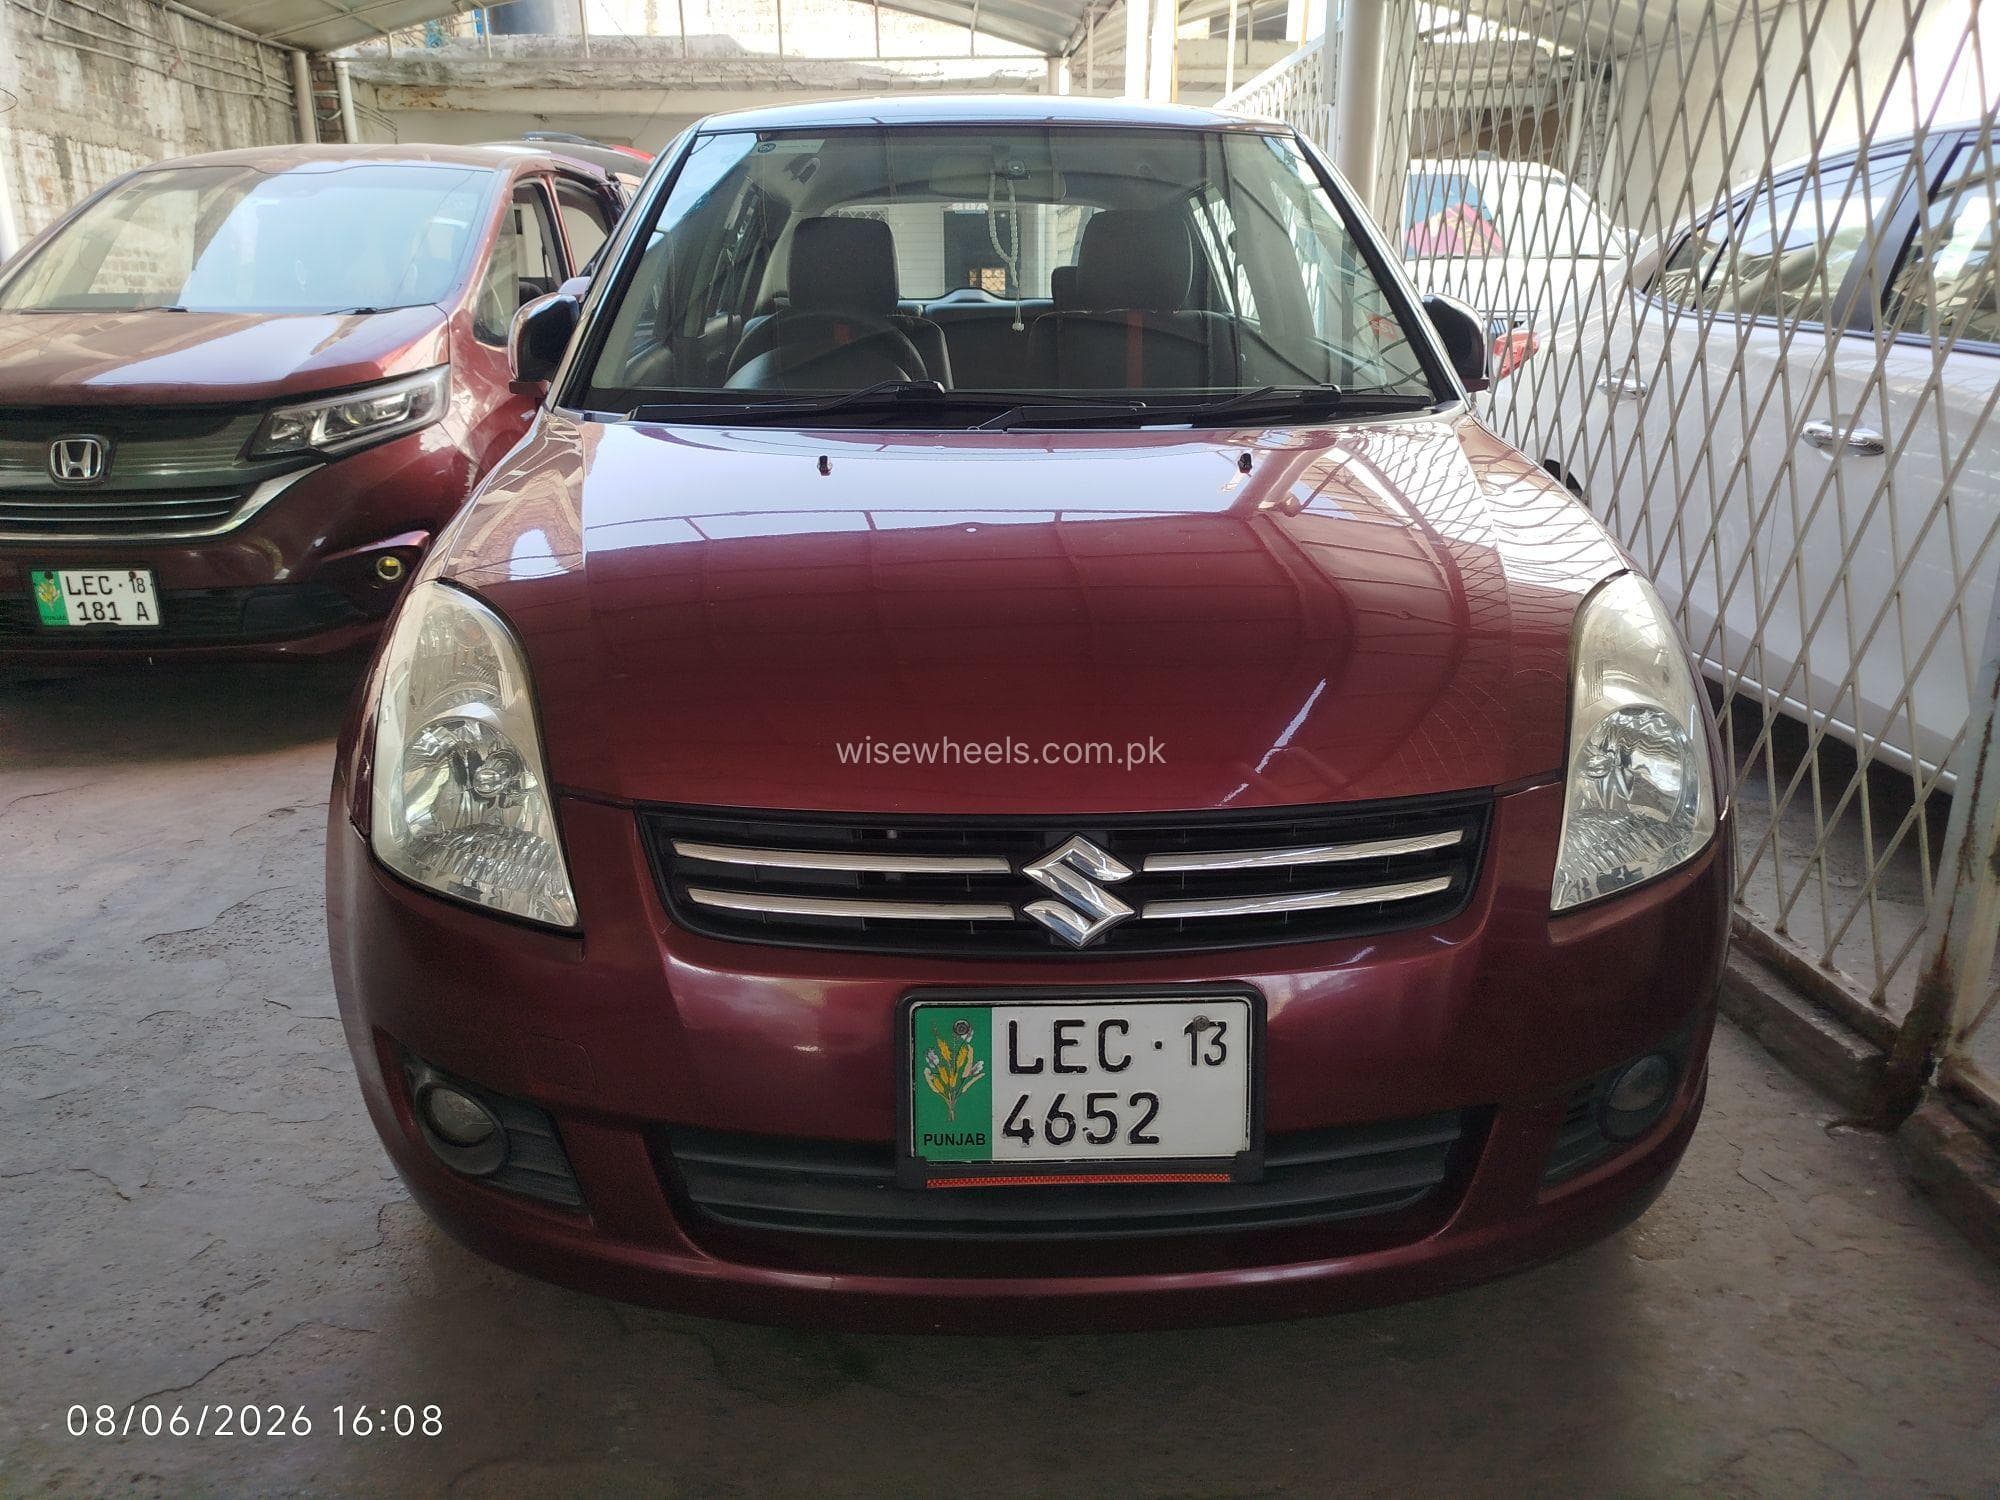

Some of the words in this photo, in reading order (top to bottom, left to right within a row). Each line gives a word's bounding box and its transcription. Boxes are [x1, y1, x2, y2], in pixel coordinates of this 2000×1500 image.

[65, 575, 113, 596] LEC
[128, 575, 146, 594] 18
[77, 601, 122, 621] 181
[136, 601, 150, 621] A
[1008, 1019, 1132, 1075] LEC
[1183, 1018, 1228, 1067] 13
[1003, 1091, 1161, 1147] 4652
[923, 1132, 987, 1147] PUNJAB
